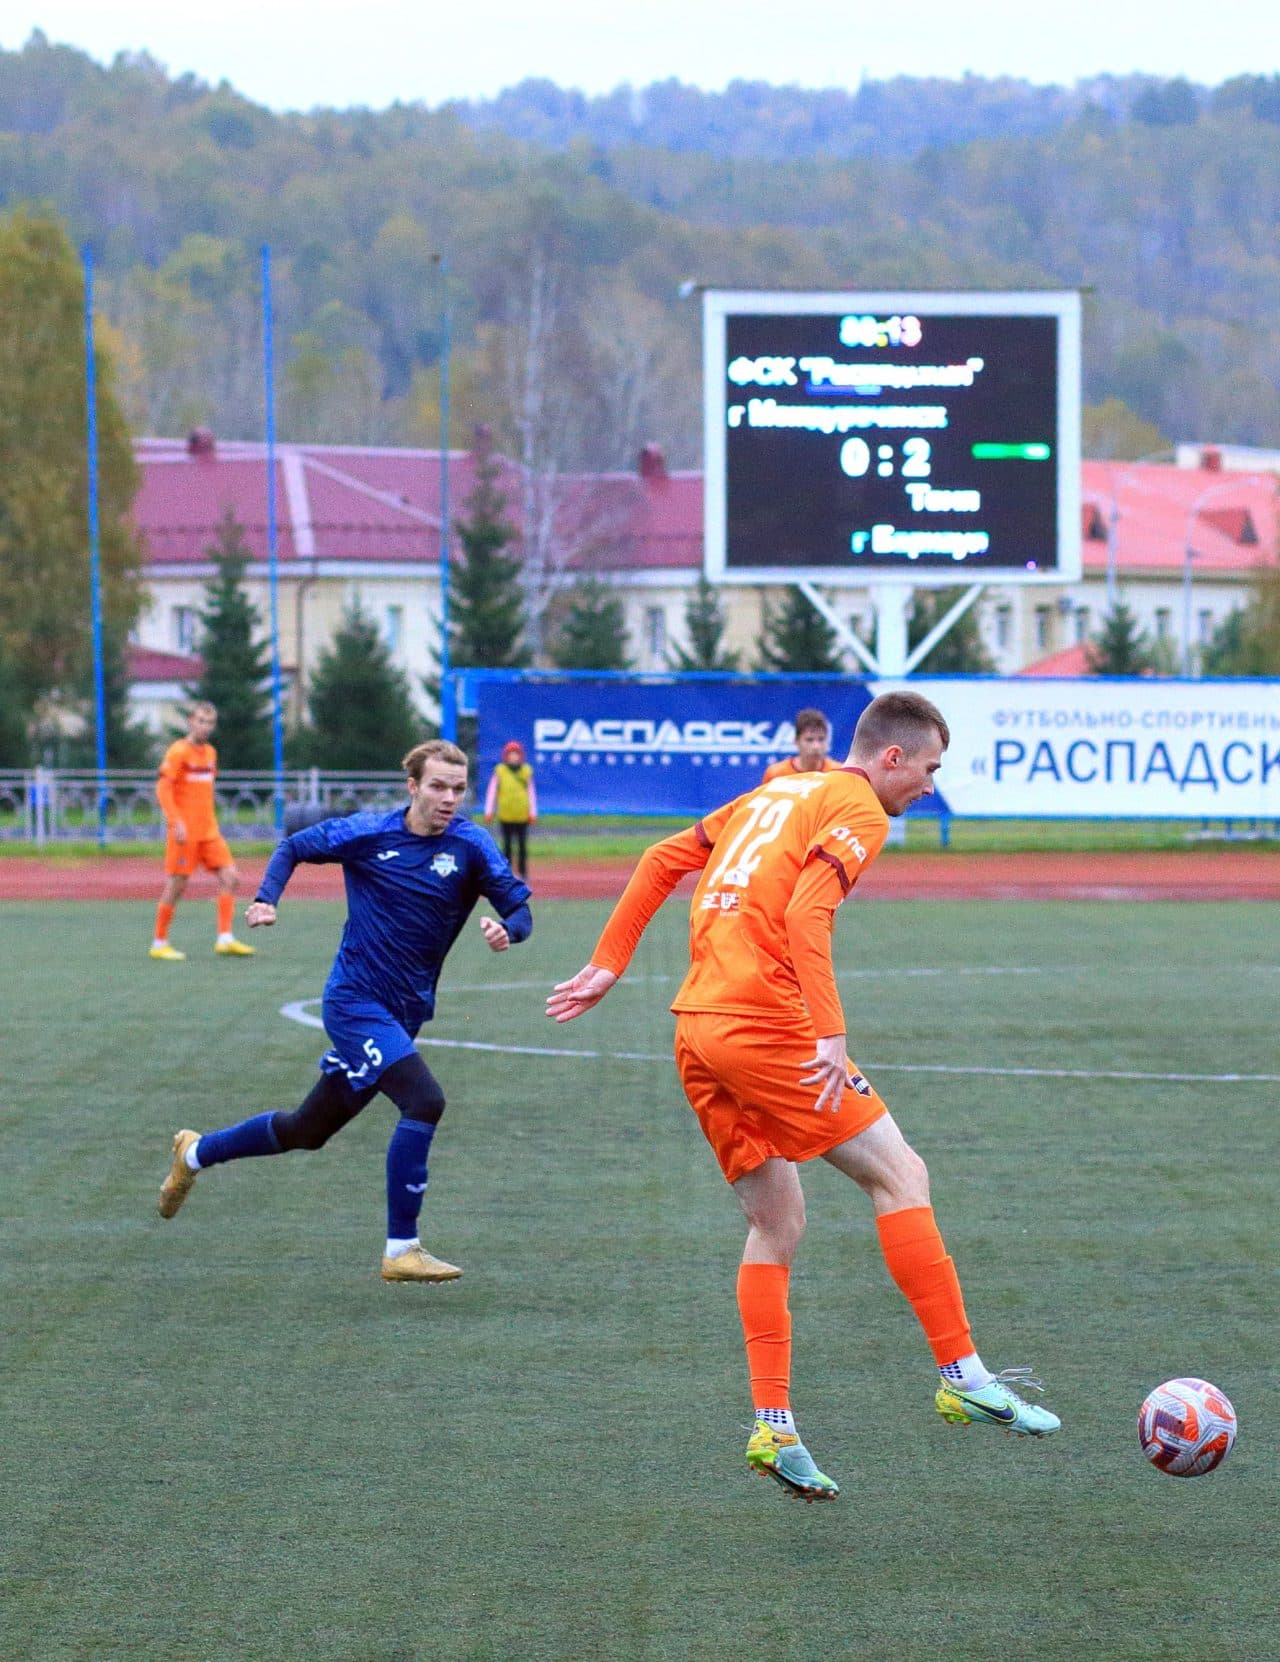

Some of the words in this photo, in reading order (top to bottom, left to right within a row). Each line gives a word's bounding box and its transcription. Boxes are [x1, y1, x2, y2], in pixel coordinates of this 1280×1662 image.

[533, 719, 832, 752] РАСПАДСКА
[707, 797, 794, 888] 12
[363, 1038, 382, 1066] 5
